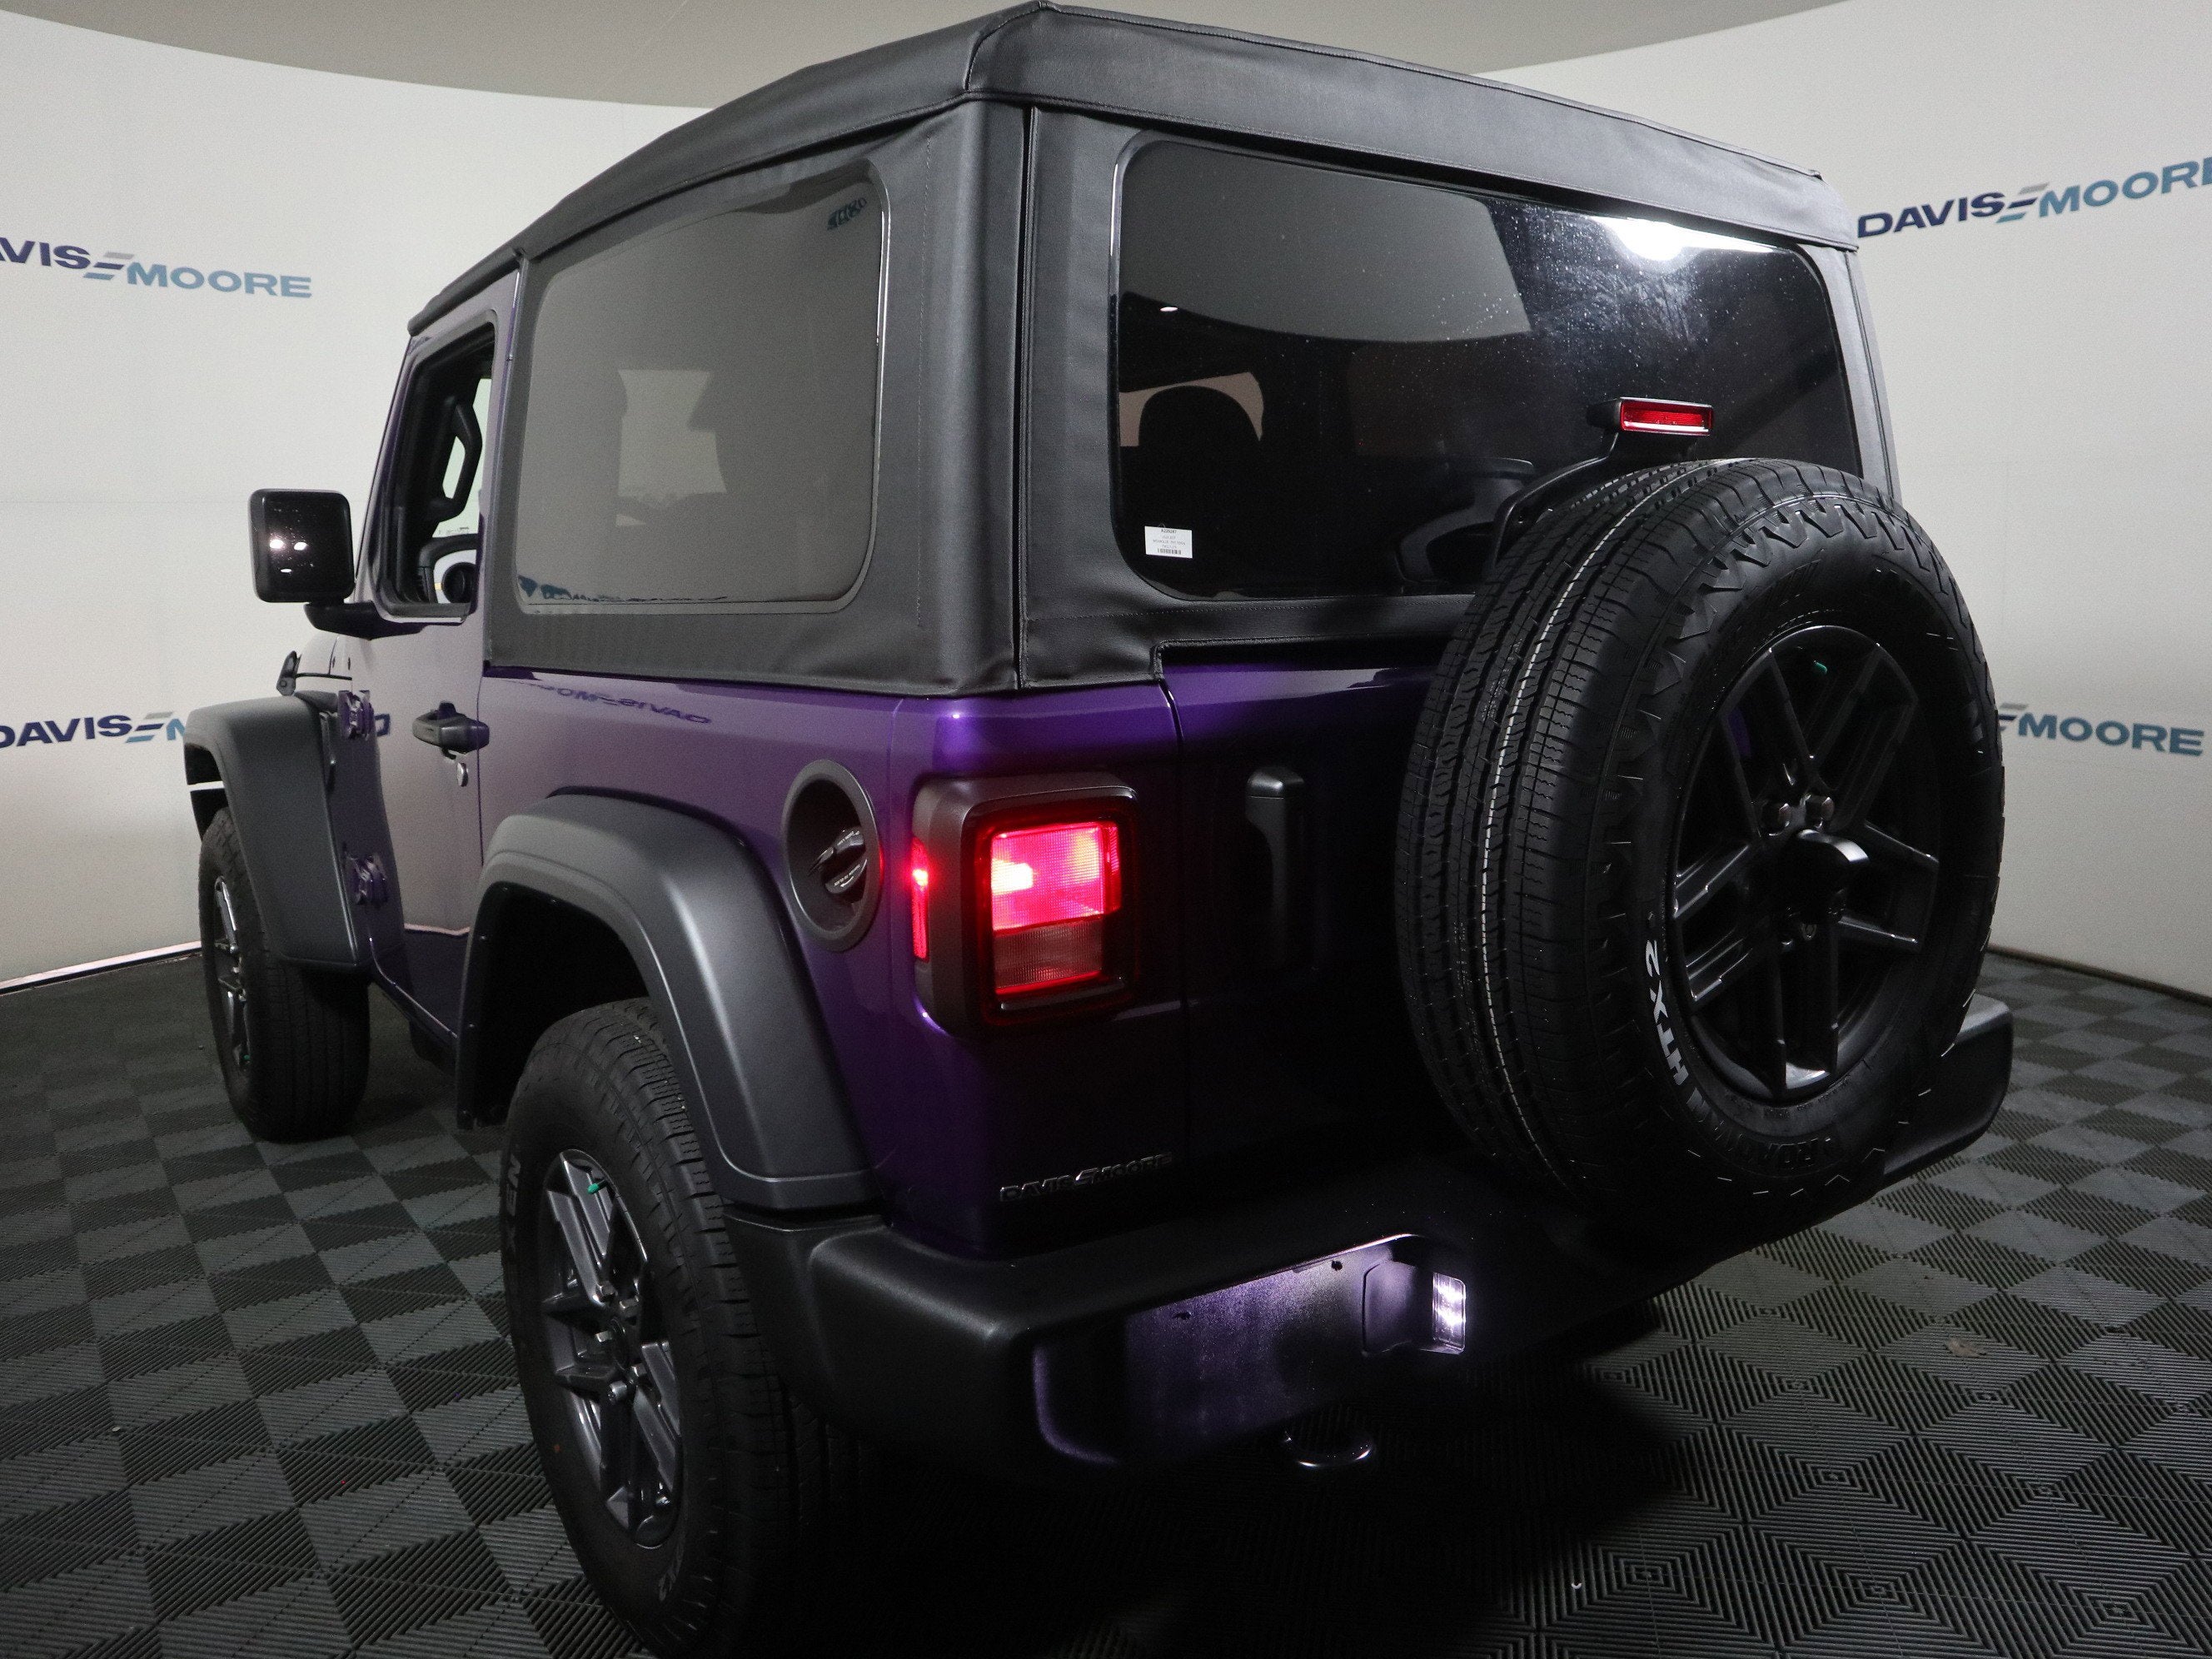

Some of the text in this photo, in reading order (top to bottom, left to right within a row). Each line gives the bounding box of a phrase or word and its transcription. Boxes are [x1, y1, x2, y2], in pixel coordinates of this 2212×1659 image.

[1857, 192, 2005, 239] DAVIS
[0, 237, 313, 298] VIS MOORE
[2018, 712, 2205, 757] MOORE
